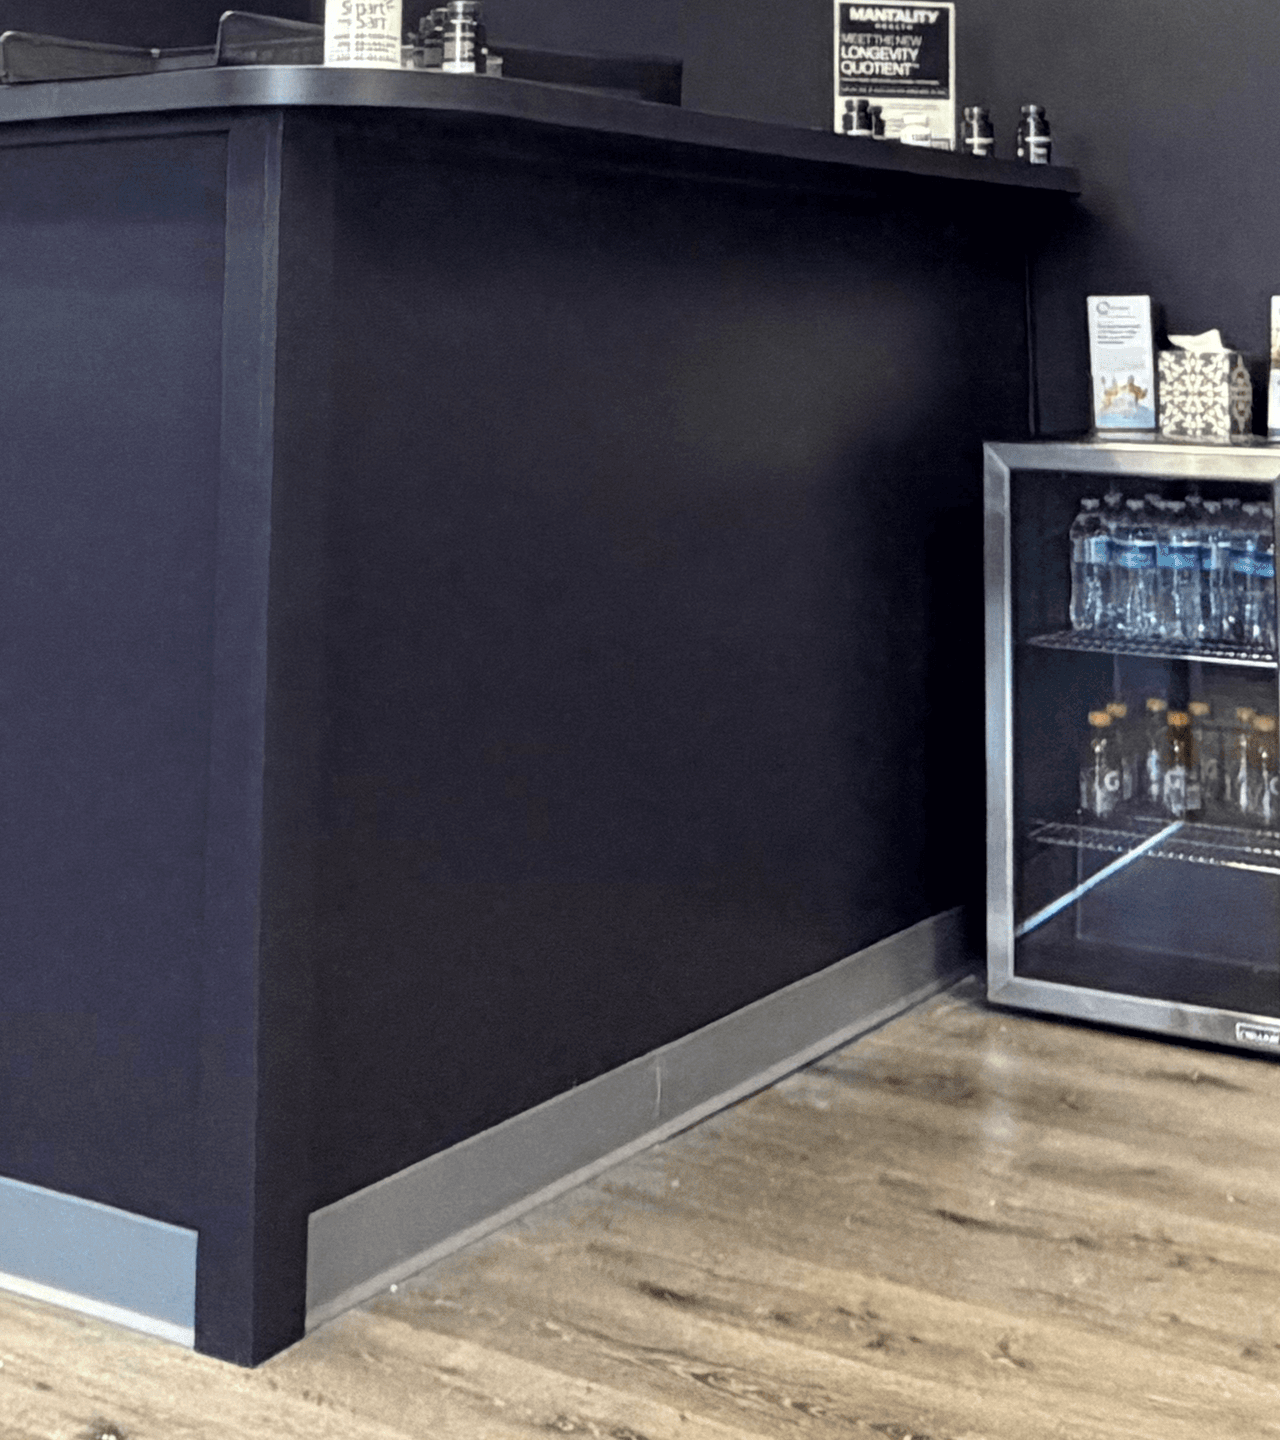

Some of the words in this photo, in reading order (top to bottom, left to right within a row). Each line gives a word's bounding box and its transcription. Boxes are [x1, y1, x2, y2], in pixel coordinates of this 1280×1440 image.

[849, 6, 940, 24] MANTALITY
[841, 33, 874, 46] MEET
[895, 34, 923, 47] NEW
[841, 45, 920, 62] LONGEVITY
